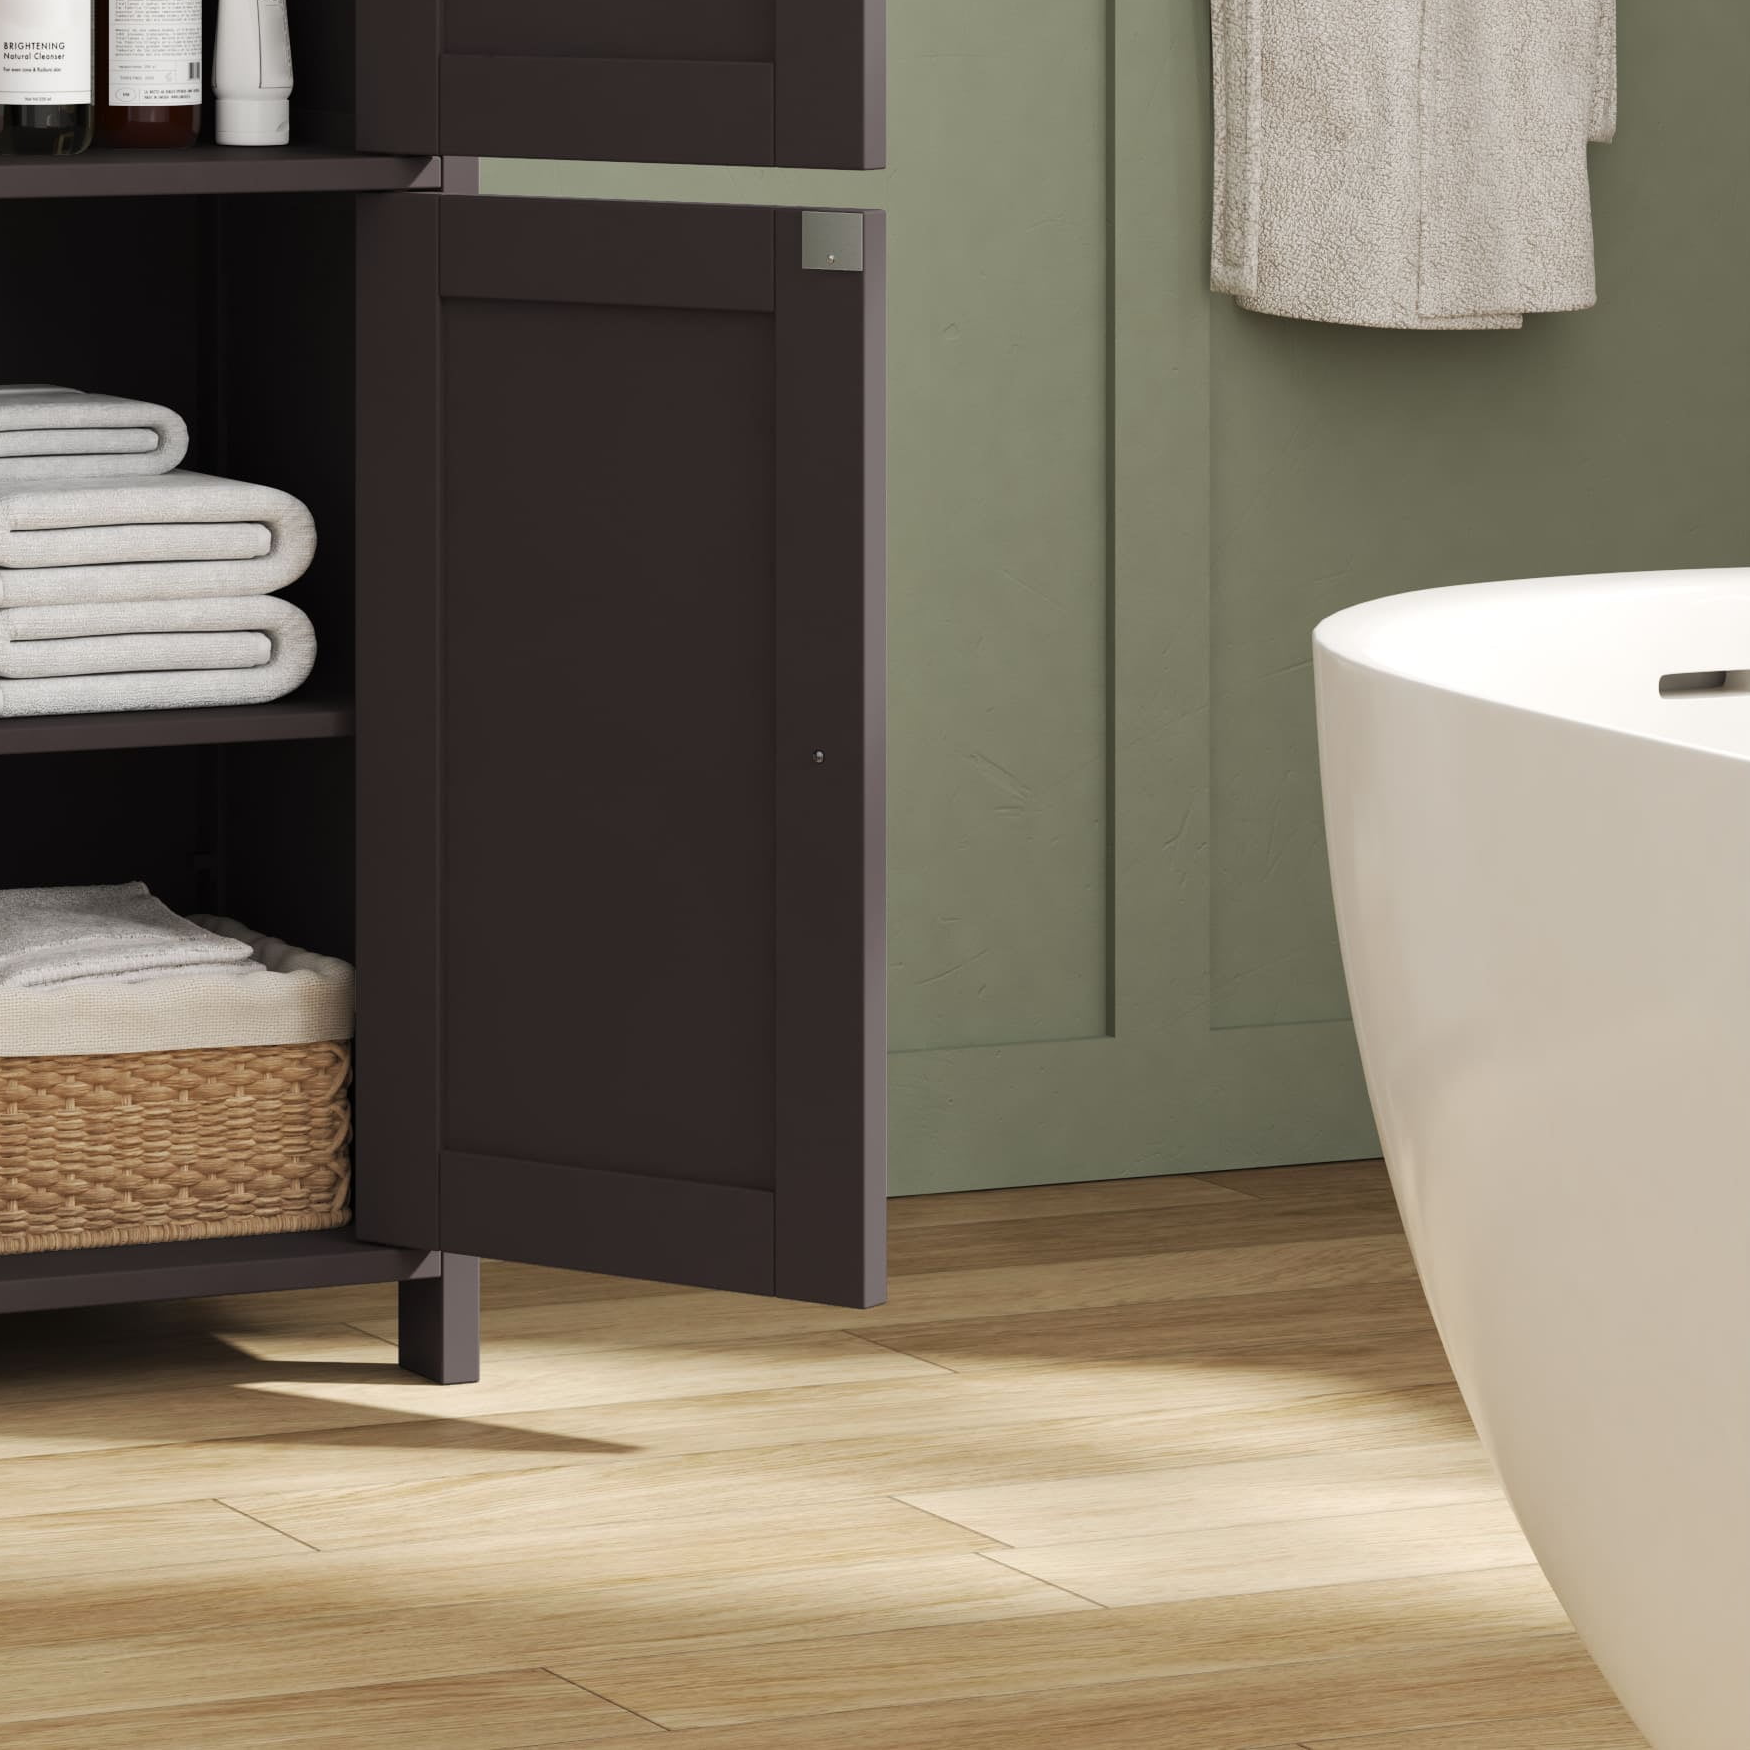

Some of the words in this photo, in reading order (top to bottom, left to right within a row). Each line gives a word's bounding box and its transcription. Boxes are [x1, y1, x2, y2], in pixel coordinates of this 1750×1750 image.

[3, 42, 65, 50] BRIGHTENING
[3, 52, 31, 60] Natural
[34, 52, 65, 60] Cleanser
